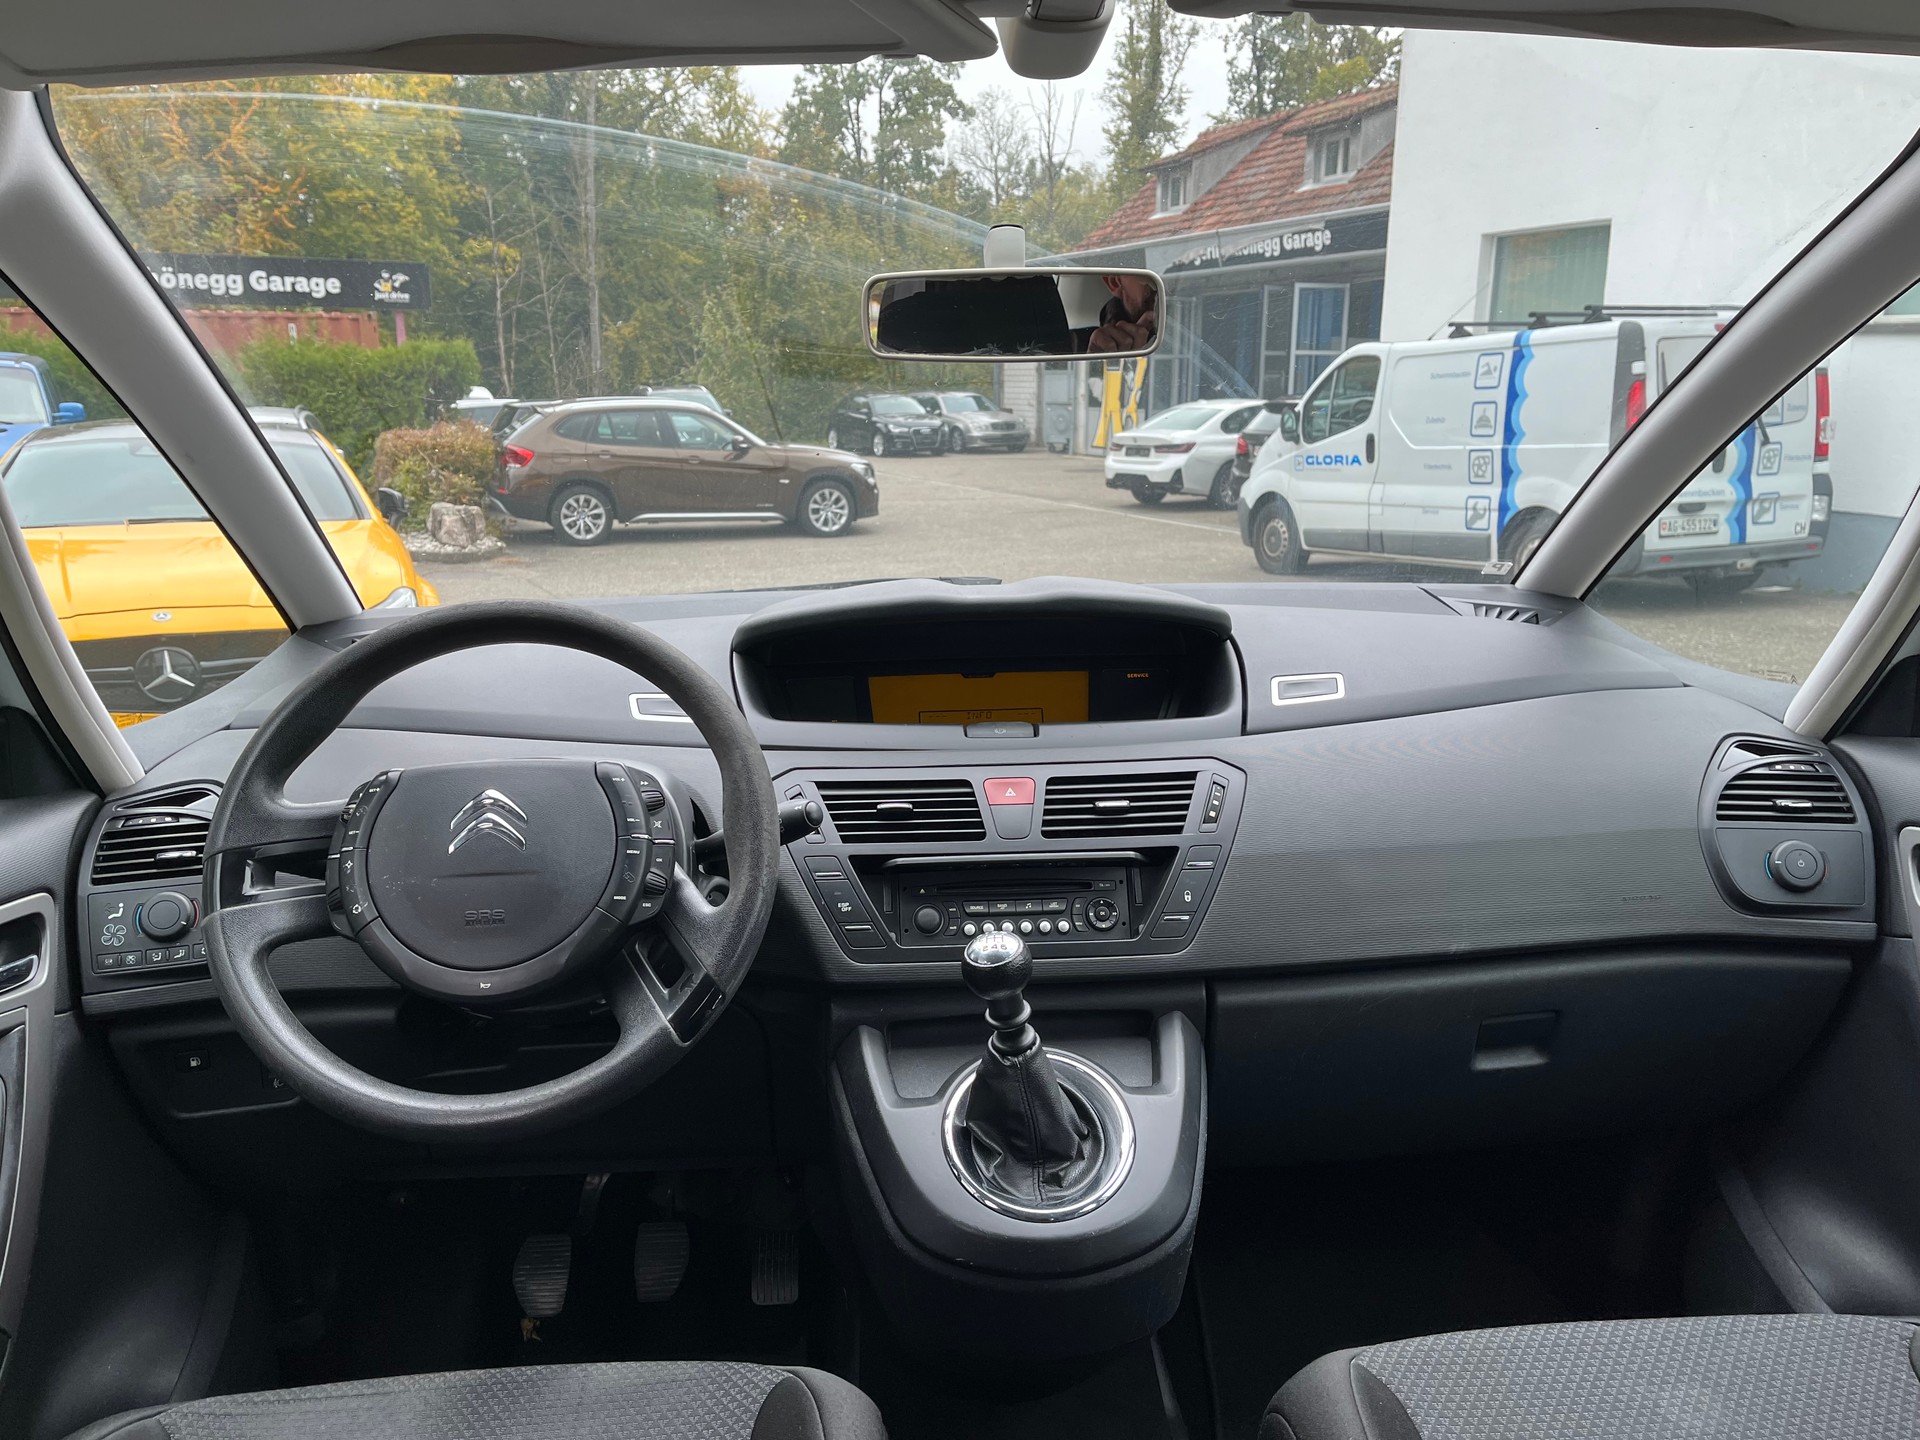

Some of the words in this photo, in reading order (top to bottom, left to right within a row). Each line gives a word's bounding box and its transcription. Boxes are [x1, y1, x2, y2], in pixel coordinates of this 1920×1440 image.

[1282, 229, 1332, 252] Garage
[249, 269, 342, 299] Garage
[1305, 454, 1363, 466] GLORIA
[464, 909, 506, 920] SRS
